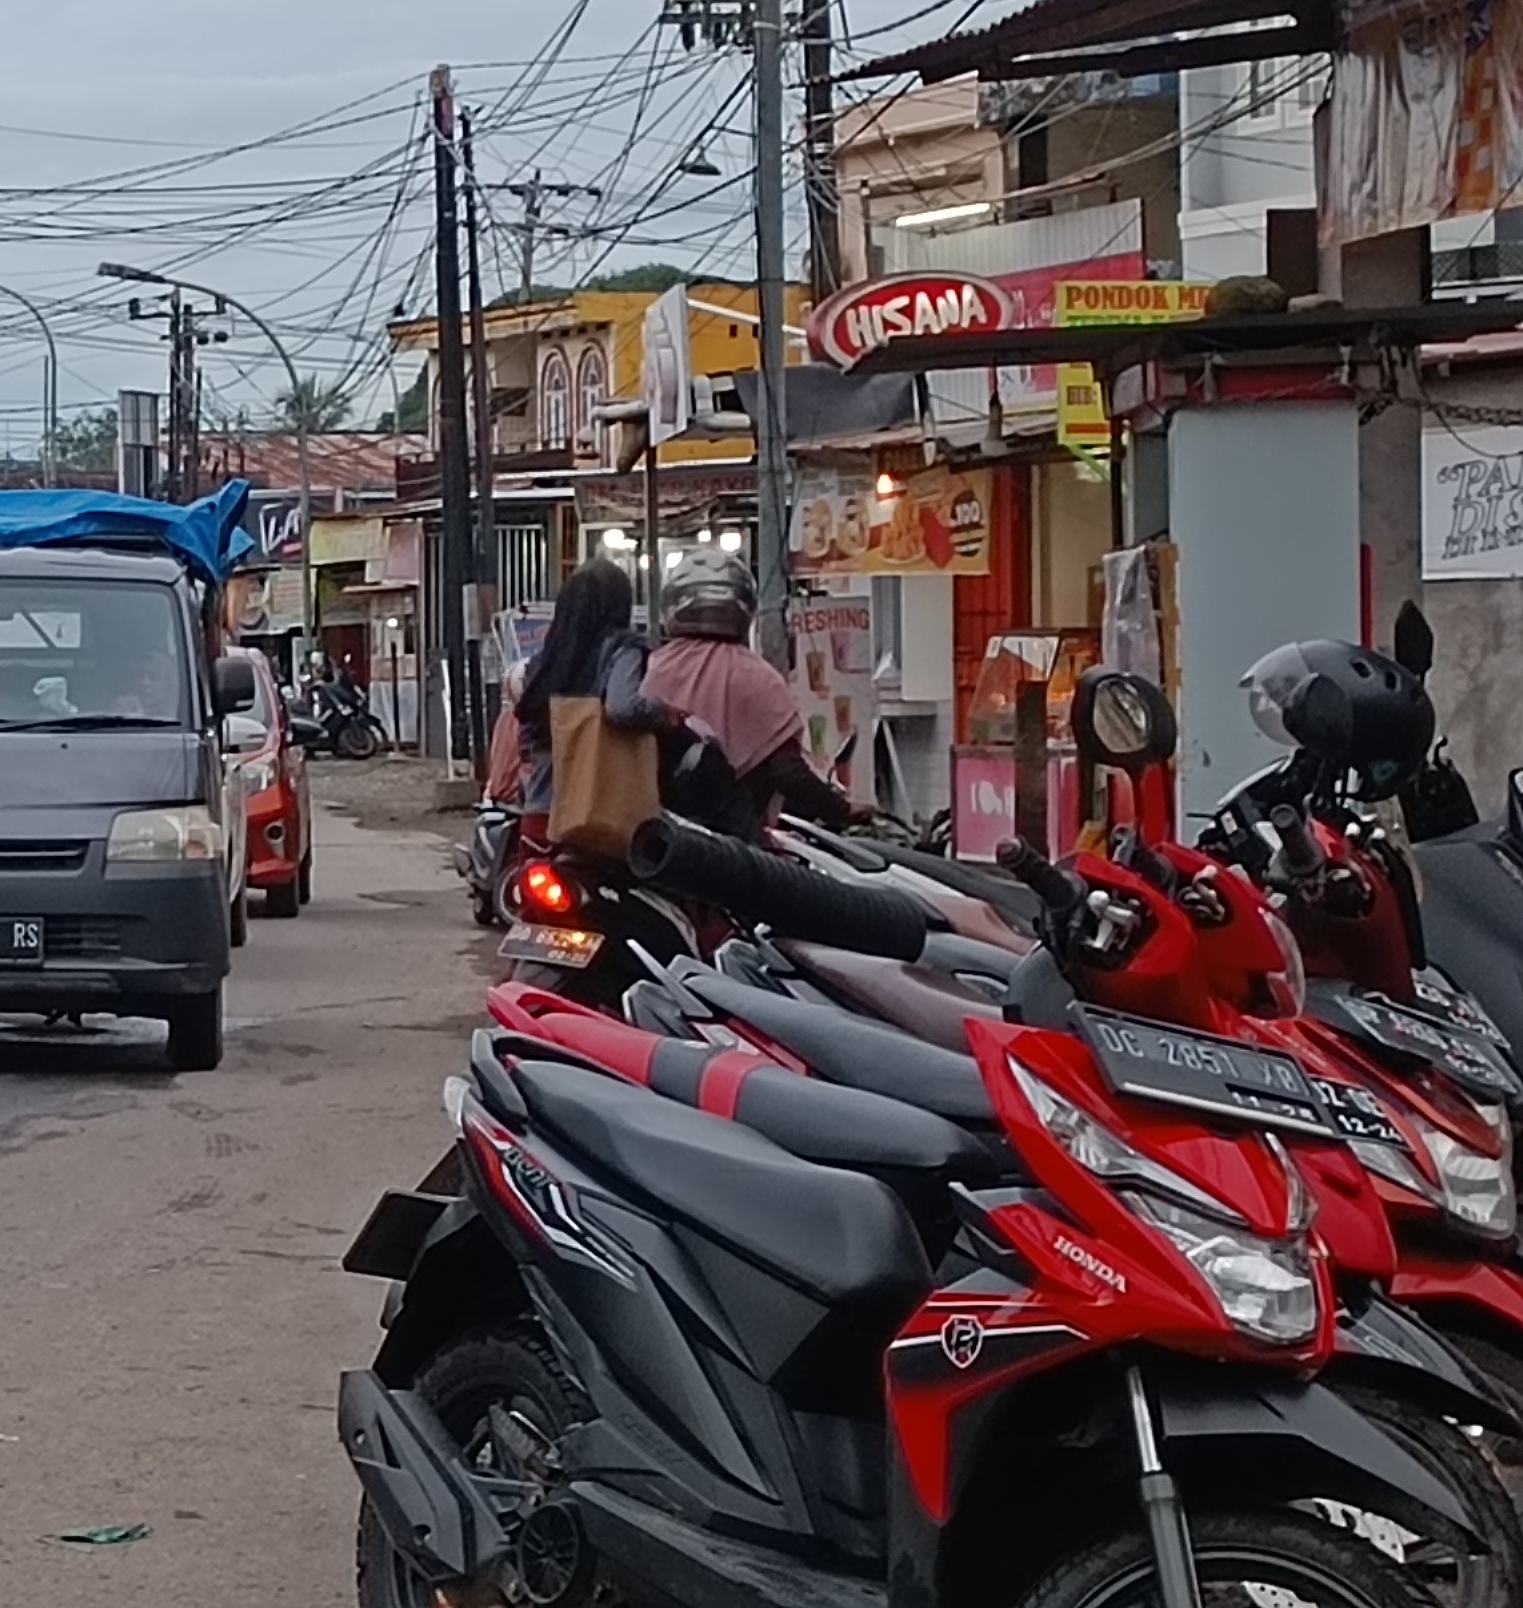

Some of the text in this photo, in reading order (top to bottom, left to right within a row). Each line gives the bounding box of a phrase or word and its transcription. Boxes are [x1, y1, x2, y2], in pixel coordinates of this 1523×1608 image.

[846, 284, 987, 347] HISANA
[1066, 285, 1169, 310] PONDOK
[13, 923, 39, 948] RS
[1097, 1023, 1145, 1058] DC
[1158, 1037, 1239, 1078] 2851
[1053, 1235, 1126, 1294] HONDA
